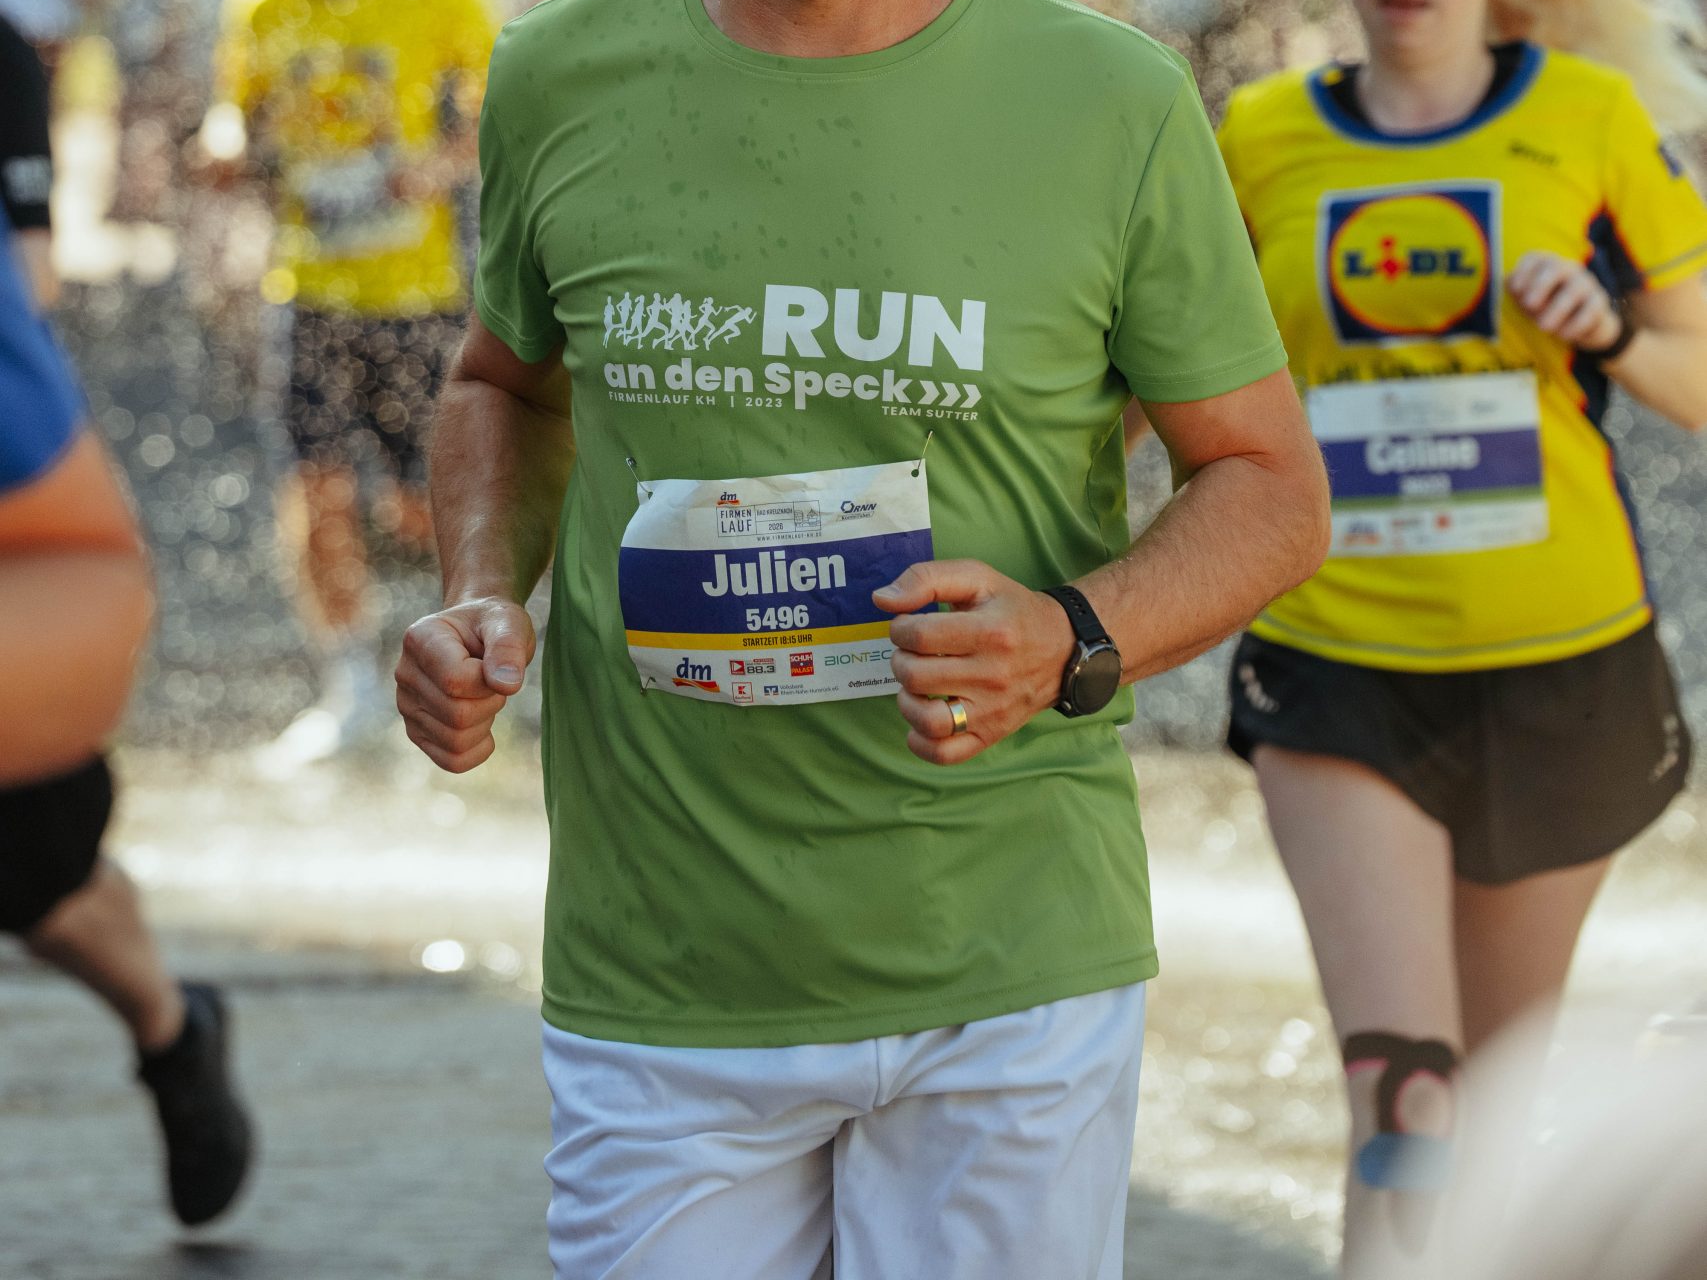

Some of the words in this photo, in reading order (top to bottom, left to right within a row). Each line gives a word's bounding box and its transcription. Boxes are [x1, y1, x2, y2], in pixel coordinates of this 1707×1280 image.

[762, 284, 986, 371] RUN
[603, 359, 656, 390] an
[664, 358, 754, 393] den
[764, 362, 912, 410] Speck
[608, 391, 690, 405] FIRMENLAUF
[695, 395, 716, 406] KH
[745, 397, 783, 408] 2023
[881, 406, 921, 417] TEAM
[926, 409, 979, 421] SUTTER
[720, 492, 737, 501] dm
[720, 509, 752, 519] FIRMEN
[721, 519, 752, 534] LAUF
[702, 550, 847, 597] Julien
[746, 605, 810, 632] 5496
[742, 636, 778, 647] STARTZEIT
[797, 634, 813, 643] UHR
[790, 654, 813, 662] SCHUH
[824, 649, 893, 666] BIONTEC
[676, 657, 712, 680] dm
[746, 665, 775, 674] 88.3
[791, 666, 814, 674] PALAST
